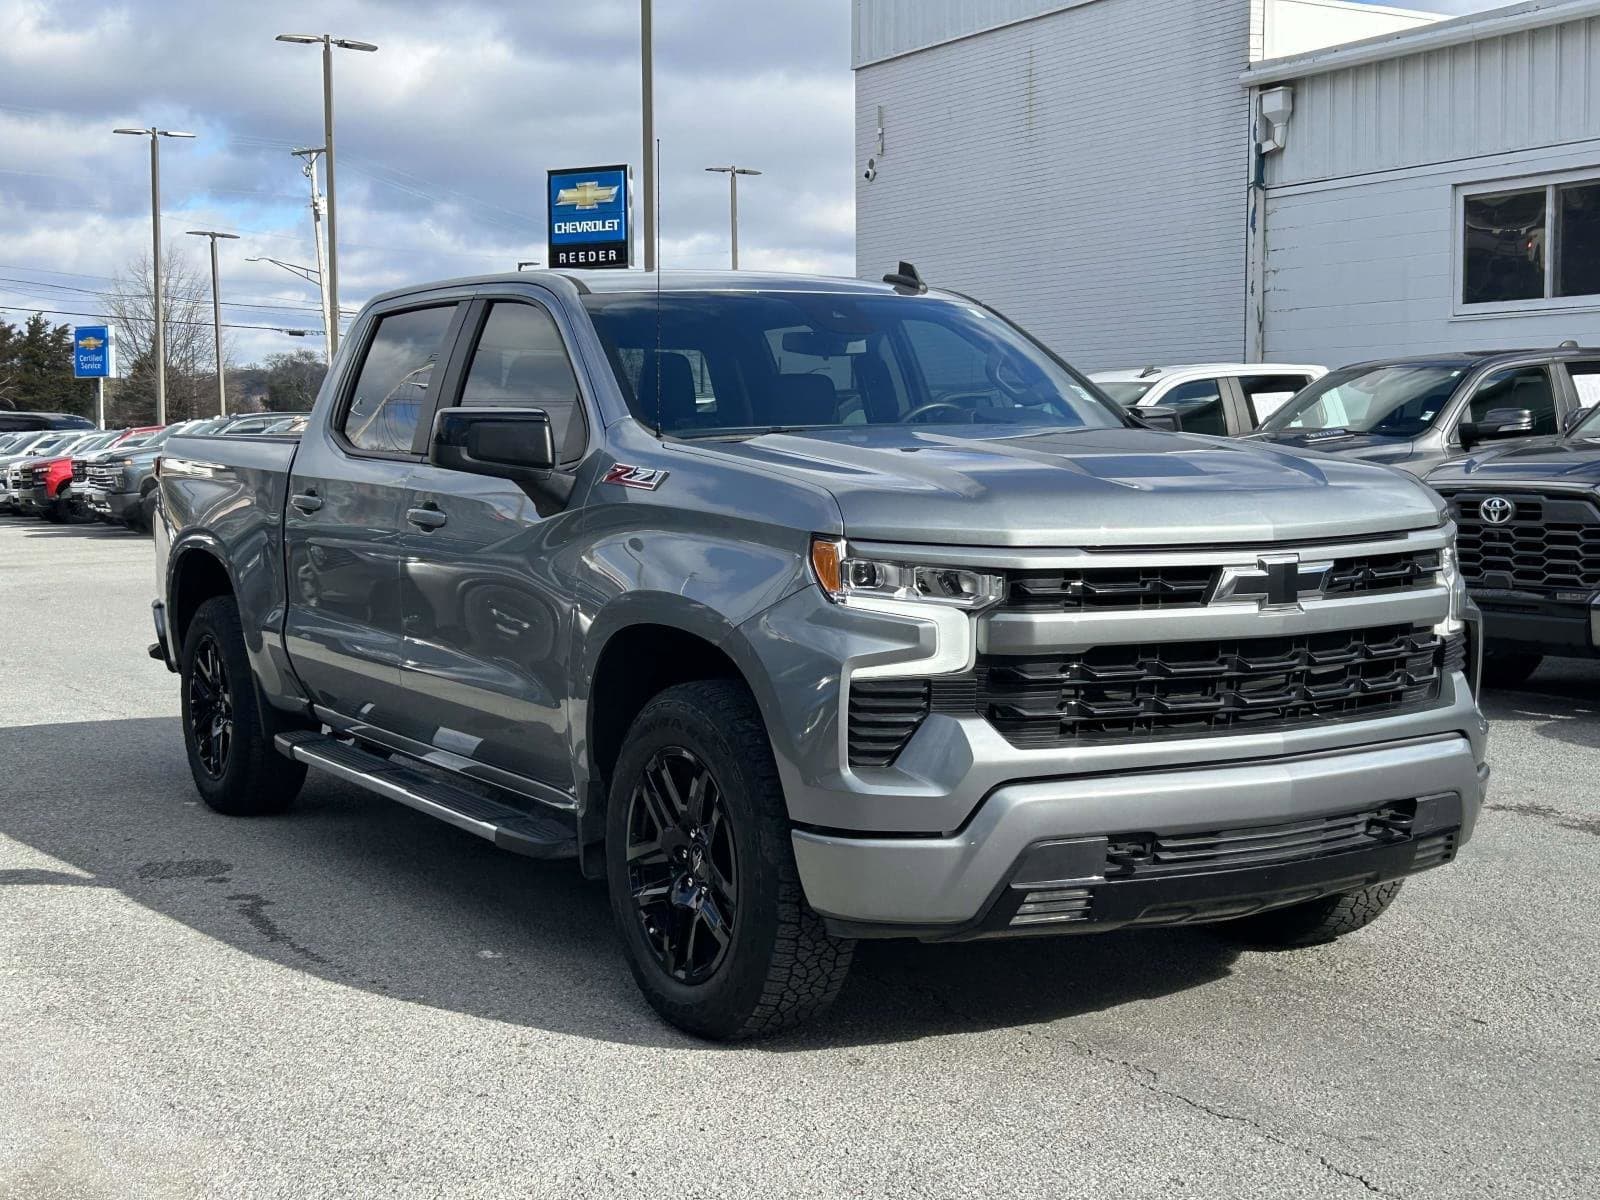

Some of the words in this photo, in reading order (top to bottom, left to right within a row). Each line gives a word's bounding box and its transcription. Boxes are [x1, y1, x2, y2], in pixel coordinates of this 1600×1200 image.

[554, 219, 620, 234] CHEVROLET
[559, 250, 617, 264] REEDER
[80, 354, 103, 362] Certified
[602, 463, 670, 491] Z71
